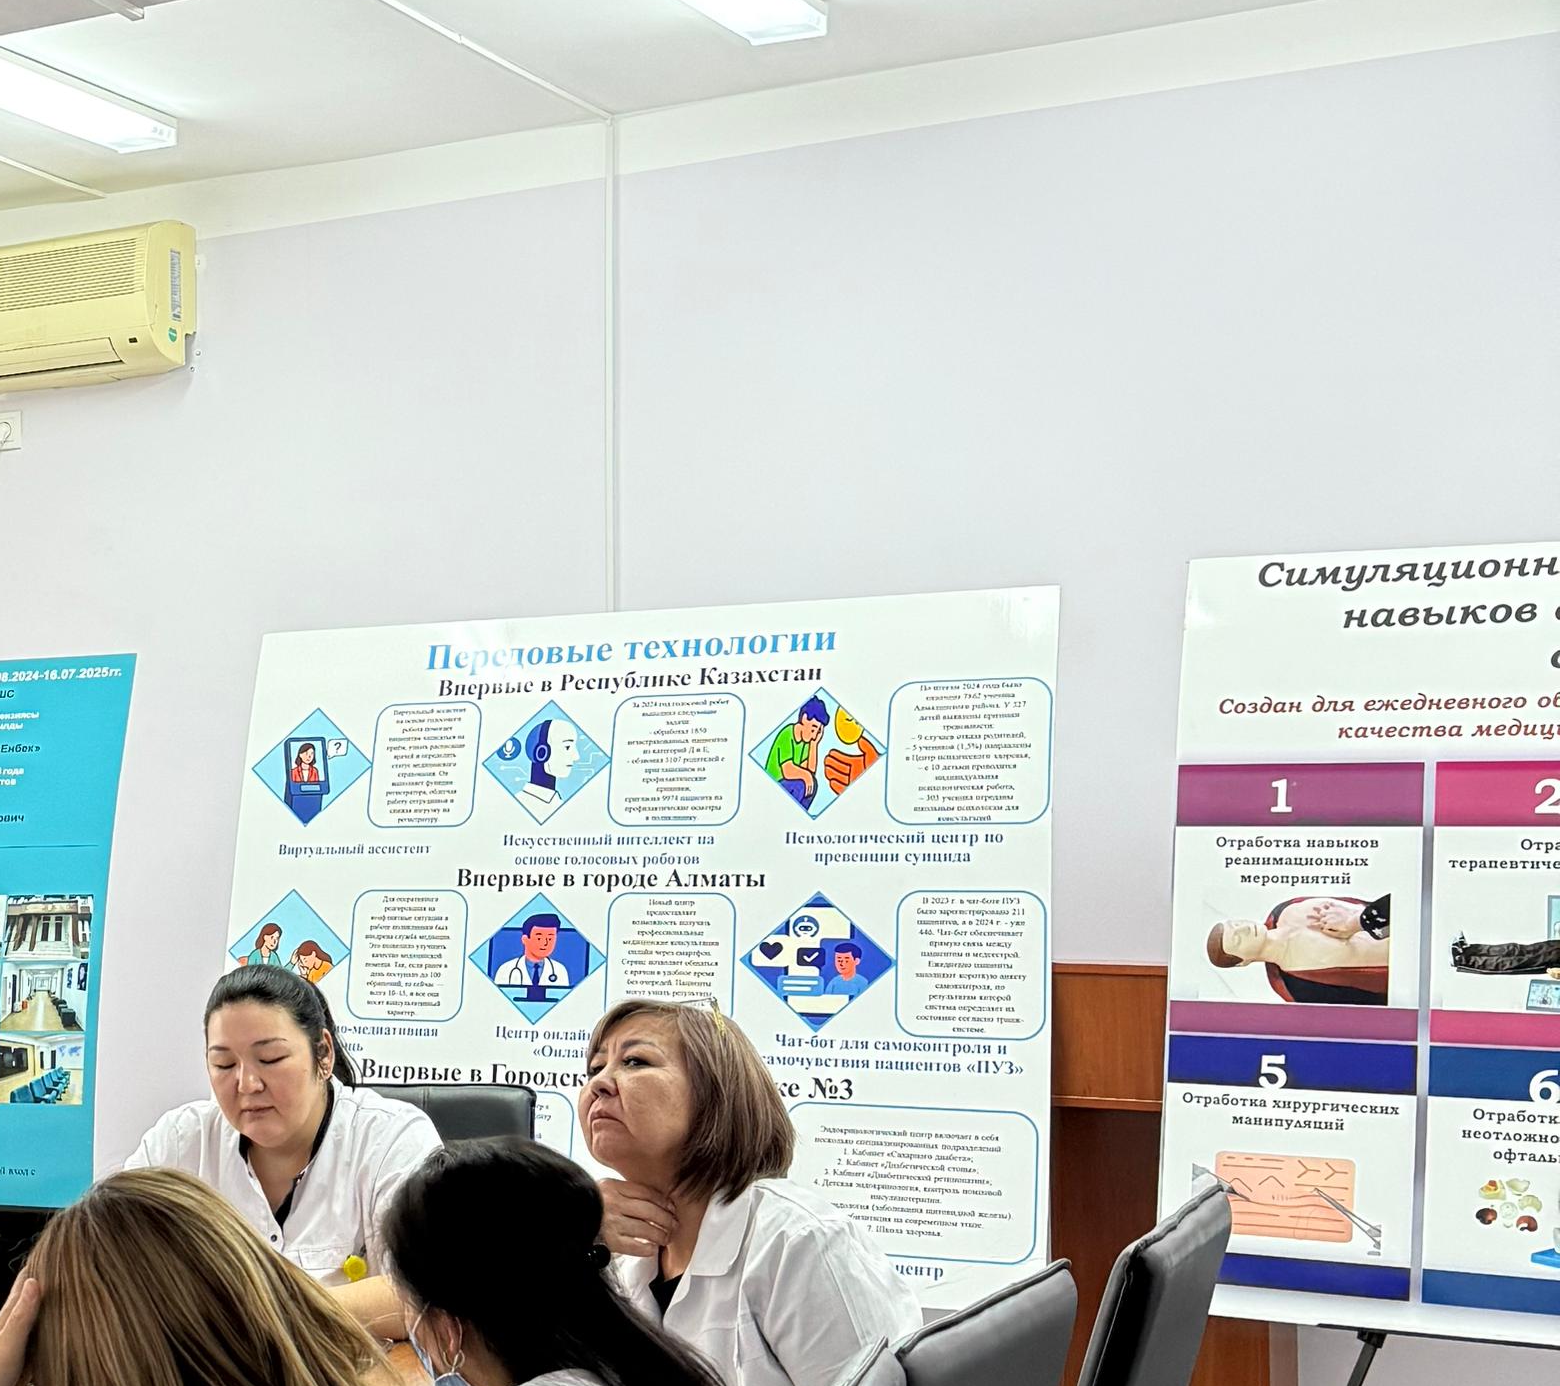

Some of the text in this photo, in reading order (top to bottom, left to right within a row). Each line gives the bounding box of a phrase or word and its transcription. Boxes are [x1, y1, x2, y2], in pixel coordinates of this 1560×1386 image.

[1258, 556, 1560, 592] Симуляционн
[1343, 603, 1538, 629] навыков
[427, 631, 837, 676] Передовые технологии
[438, 666, 822, 700] Впервые в Республике Казахстан
[1219, 696, 1302, 714] Создан
[1311, 695, 1355, 713] для
[1364, 692, 1527, 713] ежедневного
[1338, 722, 1463, 739] качества
[333, 741, 342, 754] ?
[3, 767, 25, 776] года
[1269, 778, 1293, 813] 1
[1533, 778, 1560, 815] 2
[503, 834, 715, 849] Искусственный интеллект на
[785, 831, 1003, 847] Психологический центр по
[1216, 836, 1379, 851] Отработка навыков
[278, 842, 432, 858] Виртуальный ассистент
[815, 851, 970, 865] превенции суицида
[515, 853, 699, 868] основе голосовых роботов
[1224, 855, 1369, 868] реанимационных
[457, 868, 766, 893] Впервые в городе Алматы
[1240, 872, 1351, 885] мероприятий
[496, 1025, 539, 1041] Центр
[776, 1034, 1007, 1057] Чат-бот для самоконтроля и
[362, 1058, 462, 1084] Впервые
[470, 1069, 482, 1083] в
[876, 1060, 961, 1074] пациентов
[966, 1060, 1024, 1075] «ПУЗ»
[1258, 1054, 1288, 1090] 5
[808, 1076, 854, 1101] №3
[1528, 1069, 1560, 1103] 6
[1182, 1091, 1400, 1116] Отработка хирургических
[1232, 1114, 1345, 1131] манипуляций
[895, 1265, 944, 1280] центр
